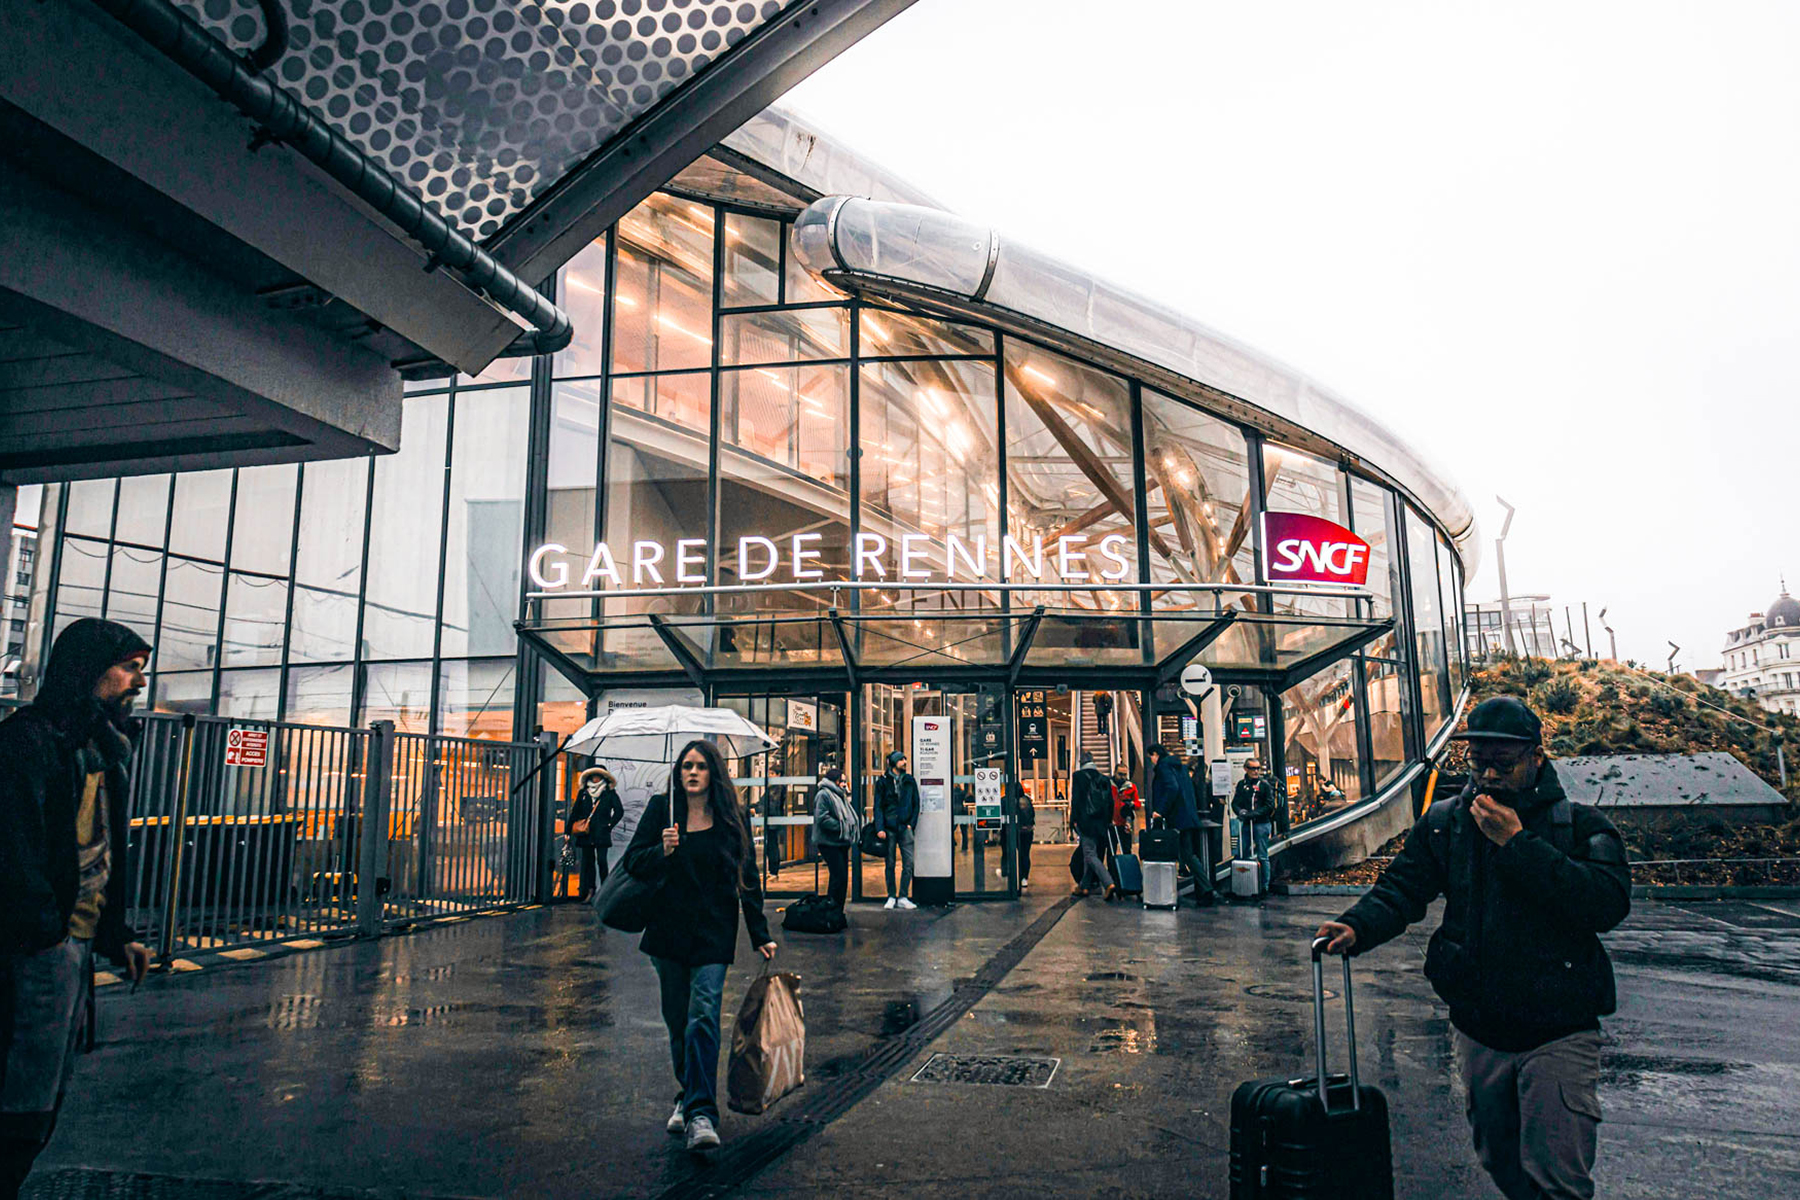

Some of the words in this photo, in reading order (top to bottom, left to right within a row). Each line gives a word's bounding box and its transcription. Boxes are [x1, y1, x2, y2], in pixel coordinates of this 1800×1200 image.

[529, 541, 708, 588] GARE
[738, 533, 825, 581] DE
[855, 532, 1129, 580] RENNES
[1272, 538, 1367, 576] SNCF
